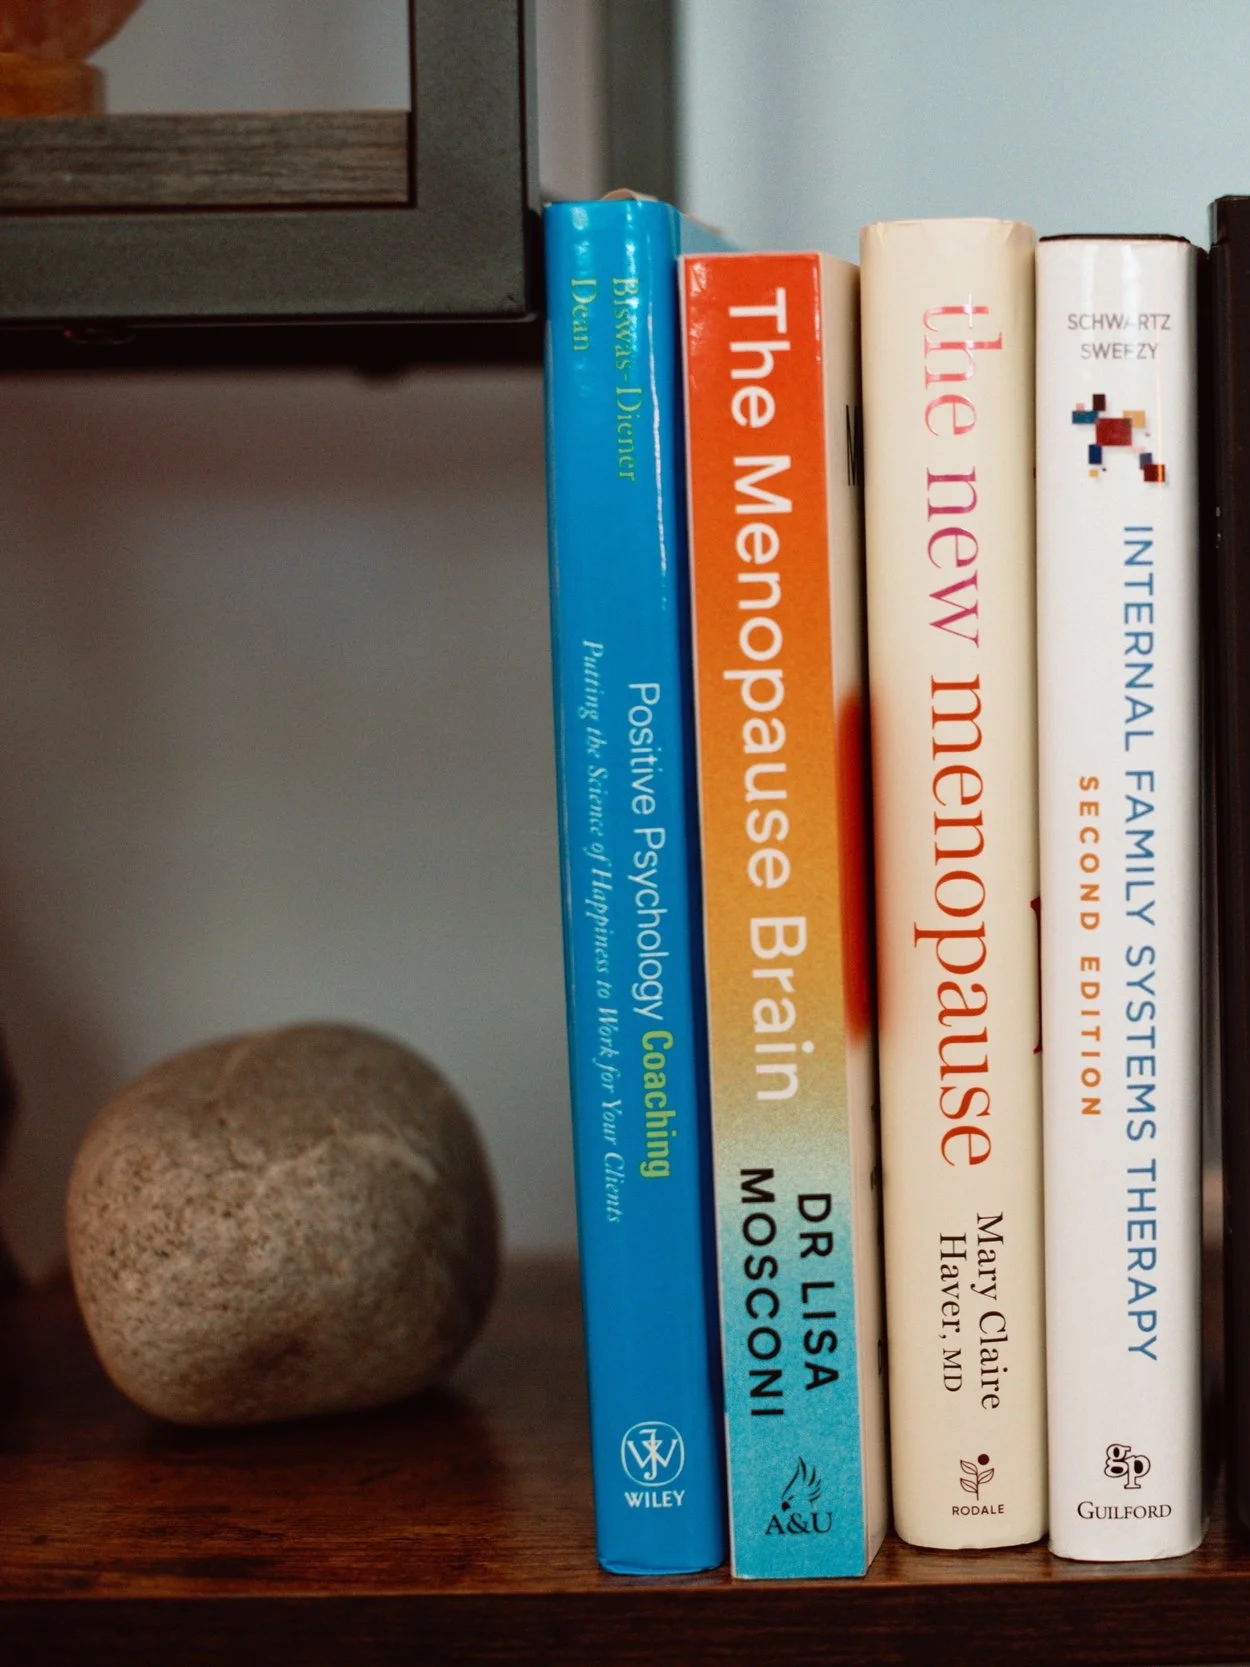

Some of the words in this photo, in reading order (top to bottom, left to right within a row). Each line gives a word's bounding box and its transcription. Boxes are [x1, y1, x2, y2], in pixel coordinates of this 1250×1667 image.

[571, 277, 597, 353] Dean
[728, 287, 791, 429] The
[922, 293, 1003, 437] the
[1080, 341, 1158, 361] SWEEZY
[612, 276, 643, 482] Biswas-Diener
[925, 466, 980, 648] new
[580, 639, 603, 722] Putting
[723, 455, 795, 890] Menopause
[1123, 525, 1155, 751] INTERNAL
[585, 727, 608, 757] the
[627, 682, 664, 816] Positive
[584, 841, 611, 863] of
[586, 765, 610, 838] Science
[1078, 774, 1100, 931] SECOND
[1124, 770, 1156, 926] FAMILY
[586, 866, 613, 976] Happiness
[628, 826, 670, 1021] Psychology
[914, 673, 993, 1166] menopause
[594, 1005, 619, 1058] Work
[597, 979, 613, 998] to
[750, 915, 815, 1101] Brain
[1080, 955, 1102, 1116] EDITION
[1125, 945, 1156, 1141] SYSTEMS
[593, 1060, 622, 1093] for
[601, 1097, 623, 1147] Your
[640, 1029, 678, 1179] Coaching
[604, 1151, 626, 1225] Clients
[797, 1192, 834, 1260] DR
[740, 1168, 785, 1417] MOSCONI
[939, 1232, 967, 1341] Haver,
[970, 1211, 1004, 1301] Mary
[1126, 1158, 1158, 1362] THERAPY
[802, 1280, 840, 1392] LISA
[941, 1347, 964, 1394] MD
[978, 1310, 1009, 1411] Claire
[624, 1490, 685, 1508] WILEY
[764, 1512, 833, 1536] A&U
[951, 1503, 1006, 1517] RODALE
